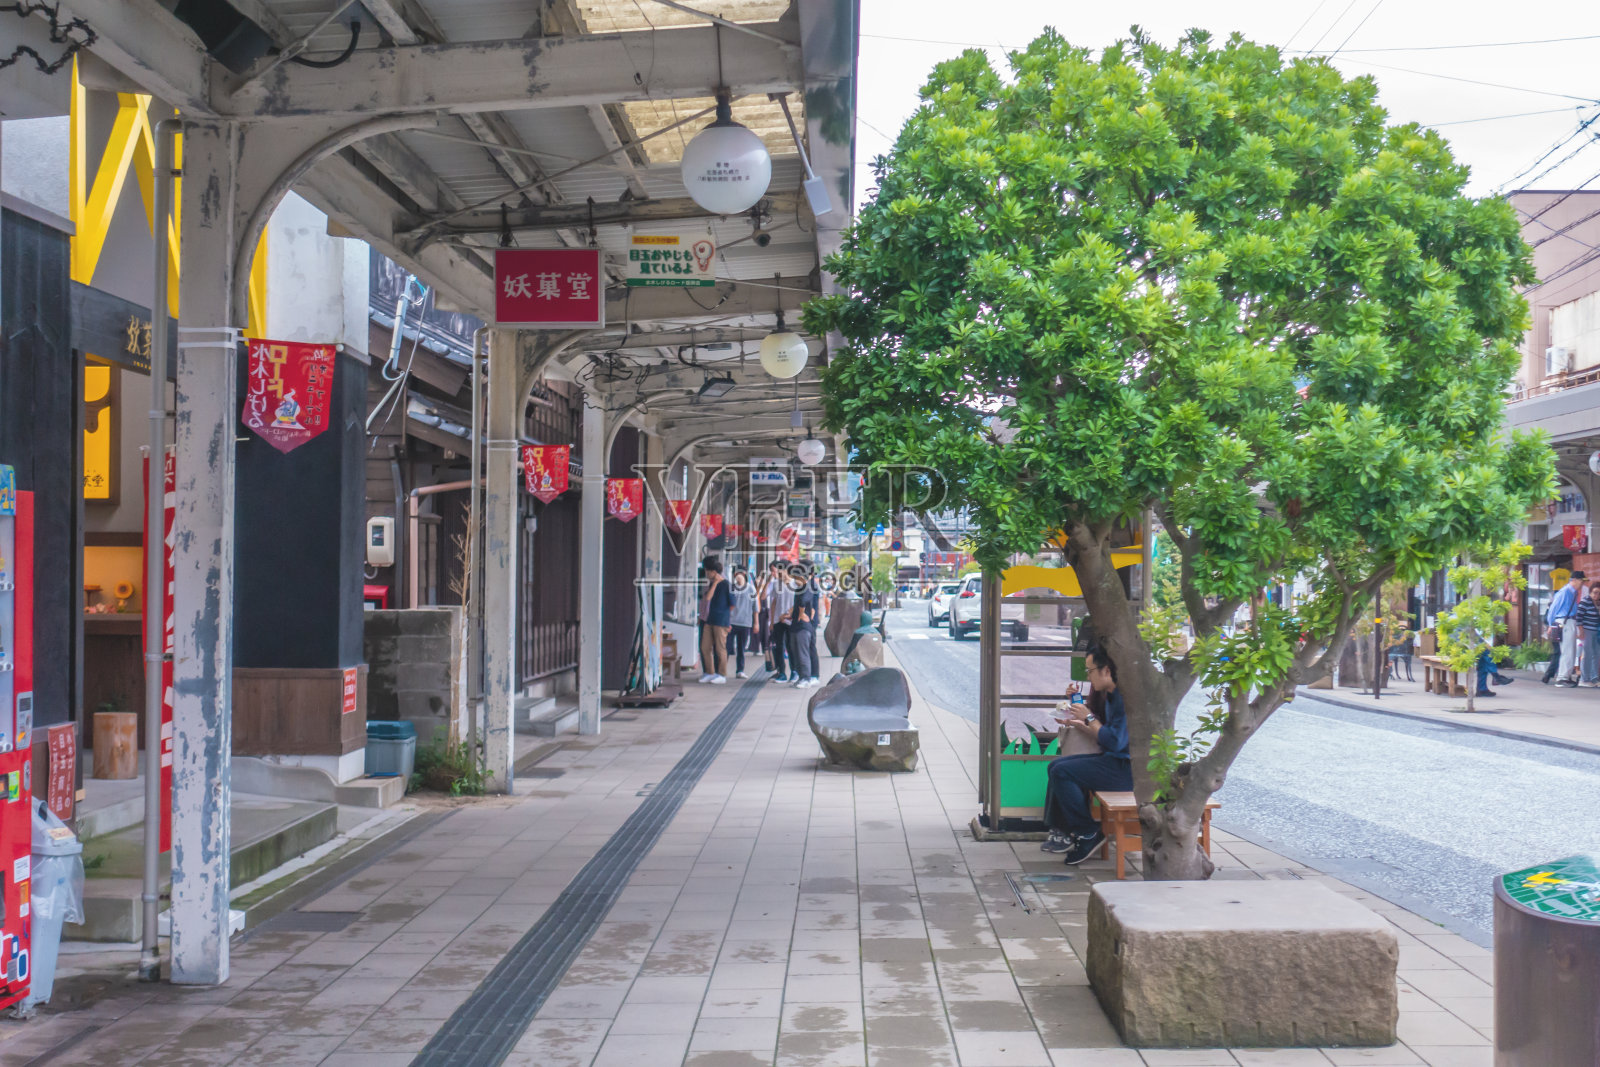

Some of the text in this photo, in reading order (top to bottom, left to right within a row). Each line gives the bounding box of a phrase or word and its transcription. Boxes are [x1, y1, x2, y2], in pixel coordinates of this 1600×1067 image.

[629, 249, 694, 262] 目玉おやじも
[640, 262, 693, 275] 見ているよ
[503, 272, 593, 301] 妖菓堂
